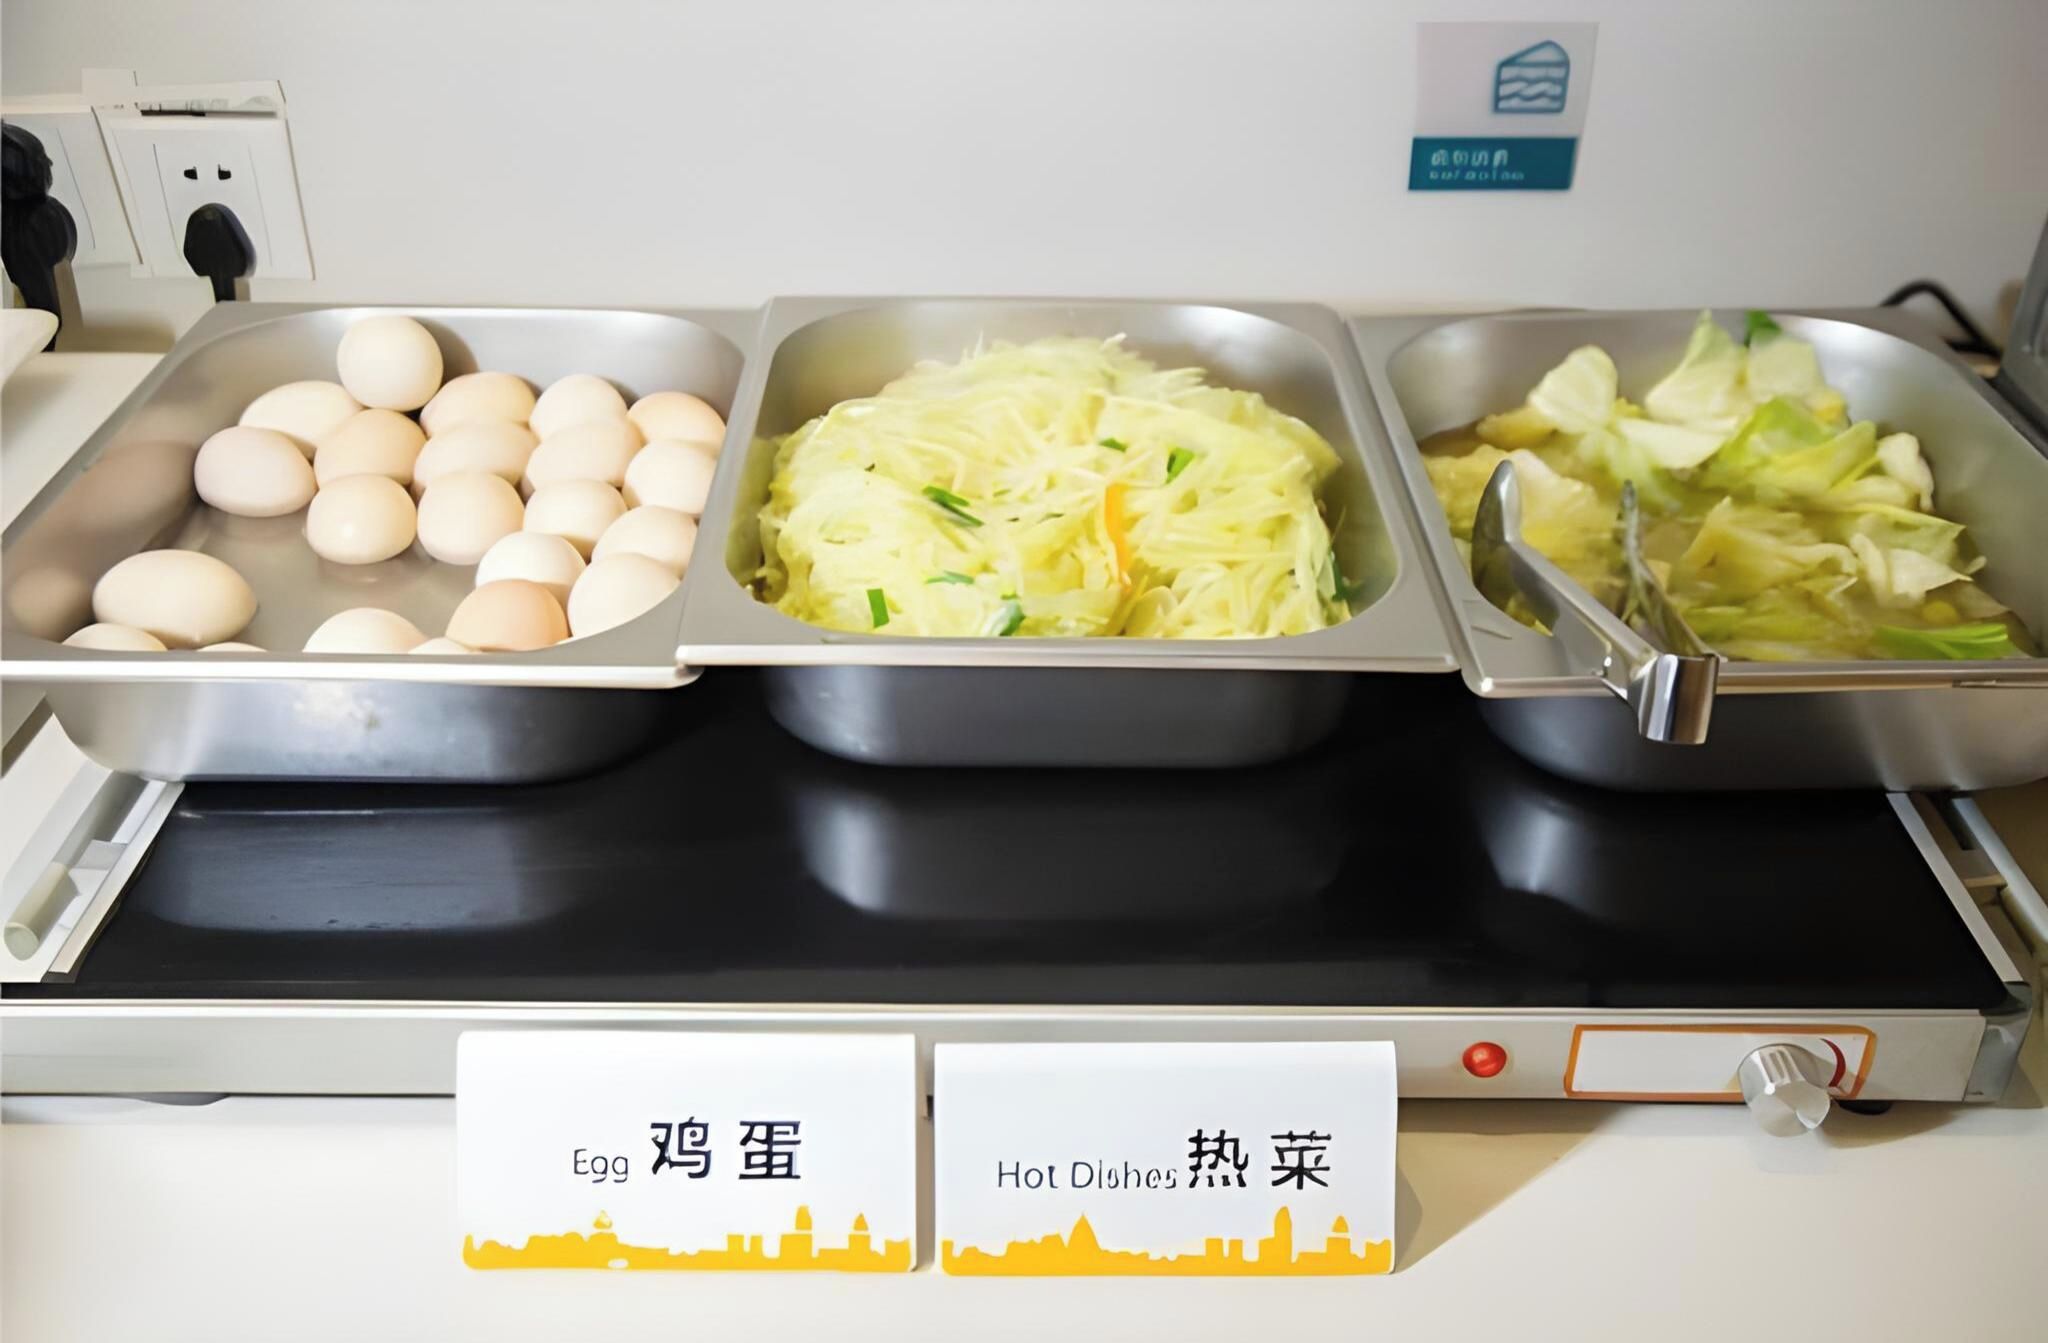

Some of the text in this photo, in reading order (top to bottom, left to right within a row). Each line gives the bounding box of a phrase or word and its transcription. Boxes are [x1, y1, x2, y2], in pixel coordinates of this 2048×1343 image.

[573, 1116, 802, 1184] Egg 鸡蛋
[998, 1128, 1332, 1191] Hot Dishes 热菜
